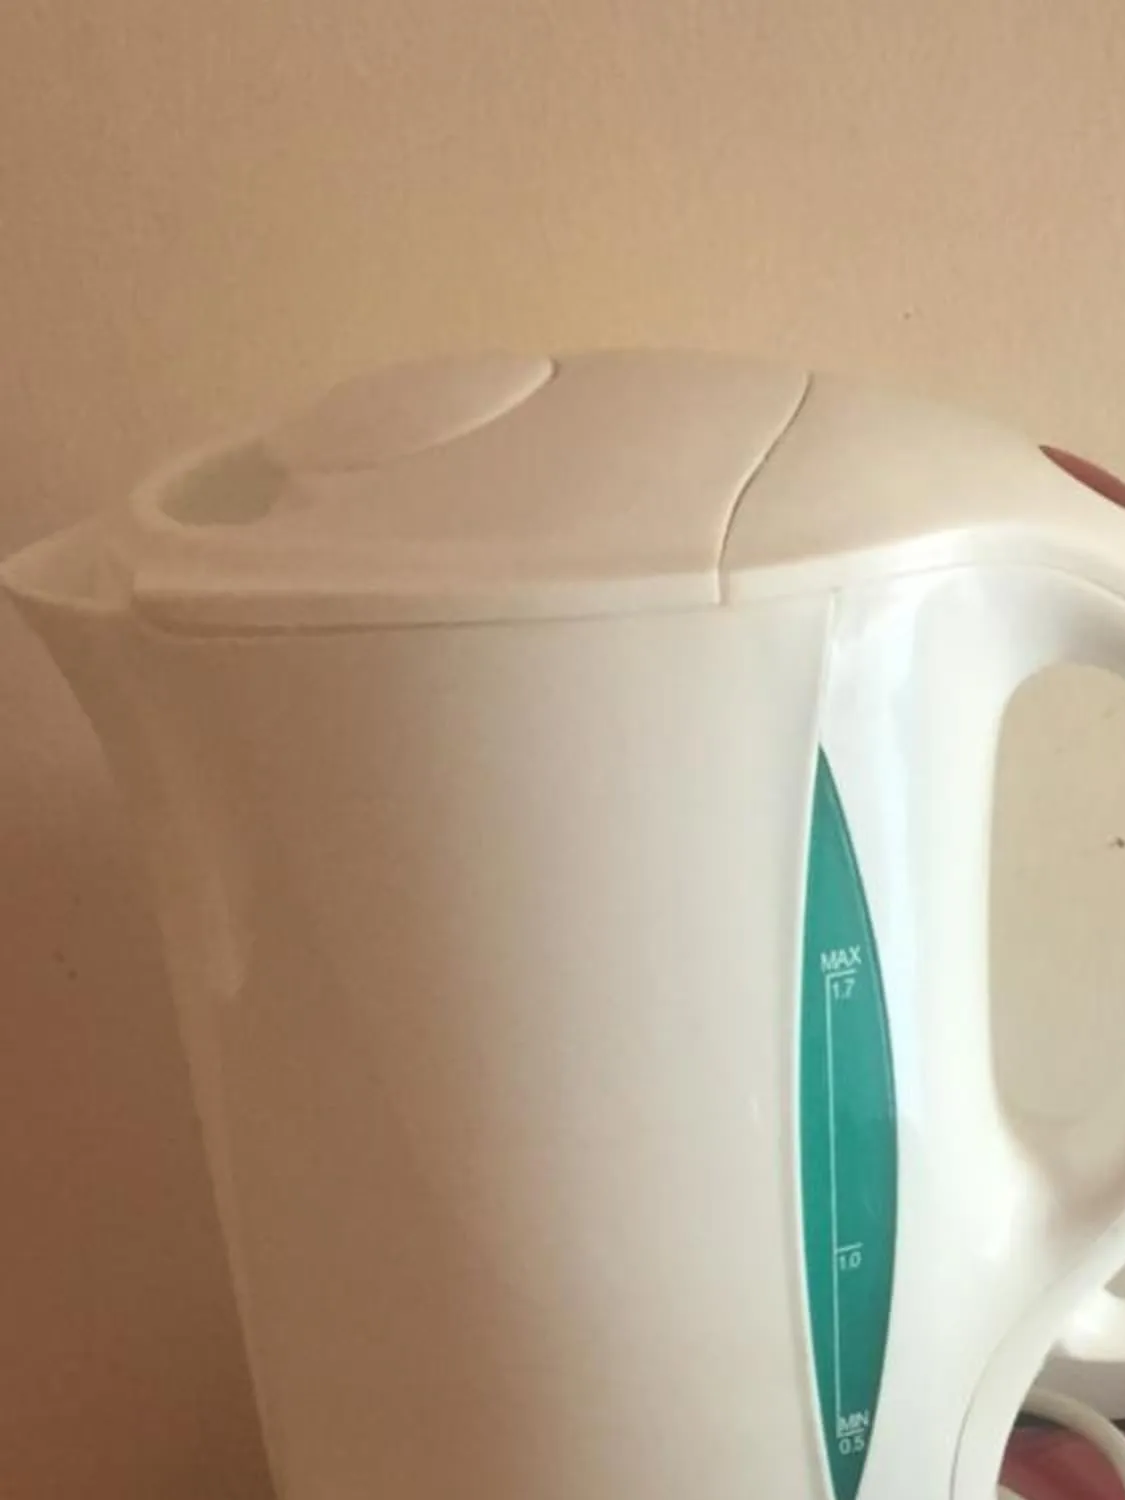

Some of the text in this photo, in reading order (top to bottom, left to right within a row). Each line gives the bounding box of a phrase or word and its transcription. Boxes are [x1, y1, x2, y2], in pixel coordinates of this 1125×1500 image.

[820, 945, 862, 973] MAX
[831, 979, 856, 999] 1.7
[838, 1252, 862, 1271] 1.0
[839, 1412, 870, 1431] MIN
[839, 1436, 865, 1456] 0.5
